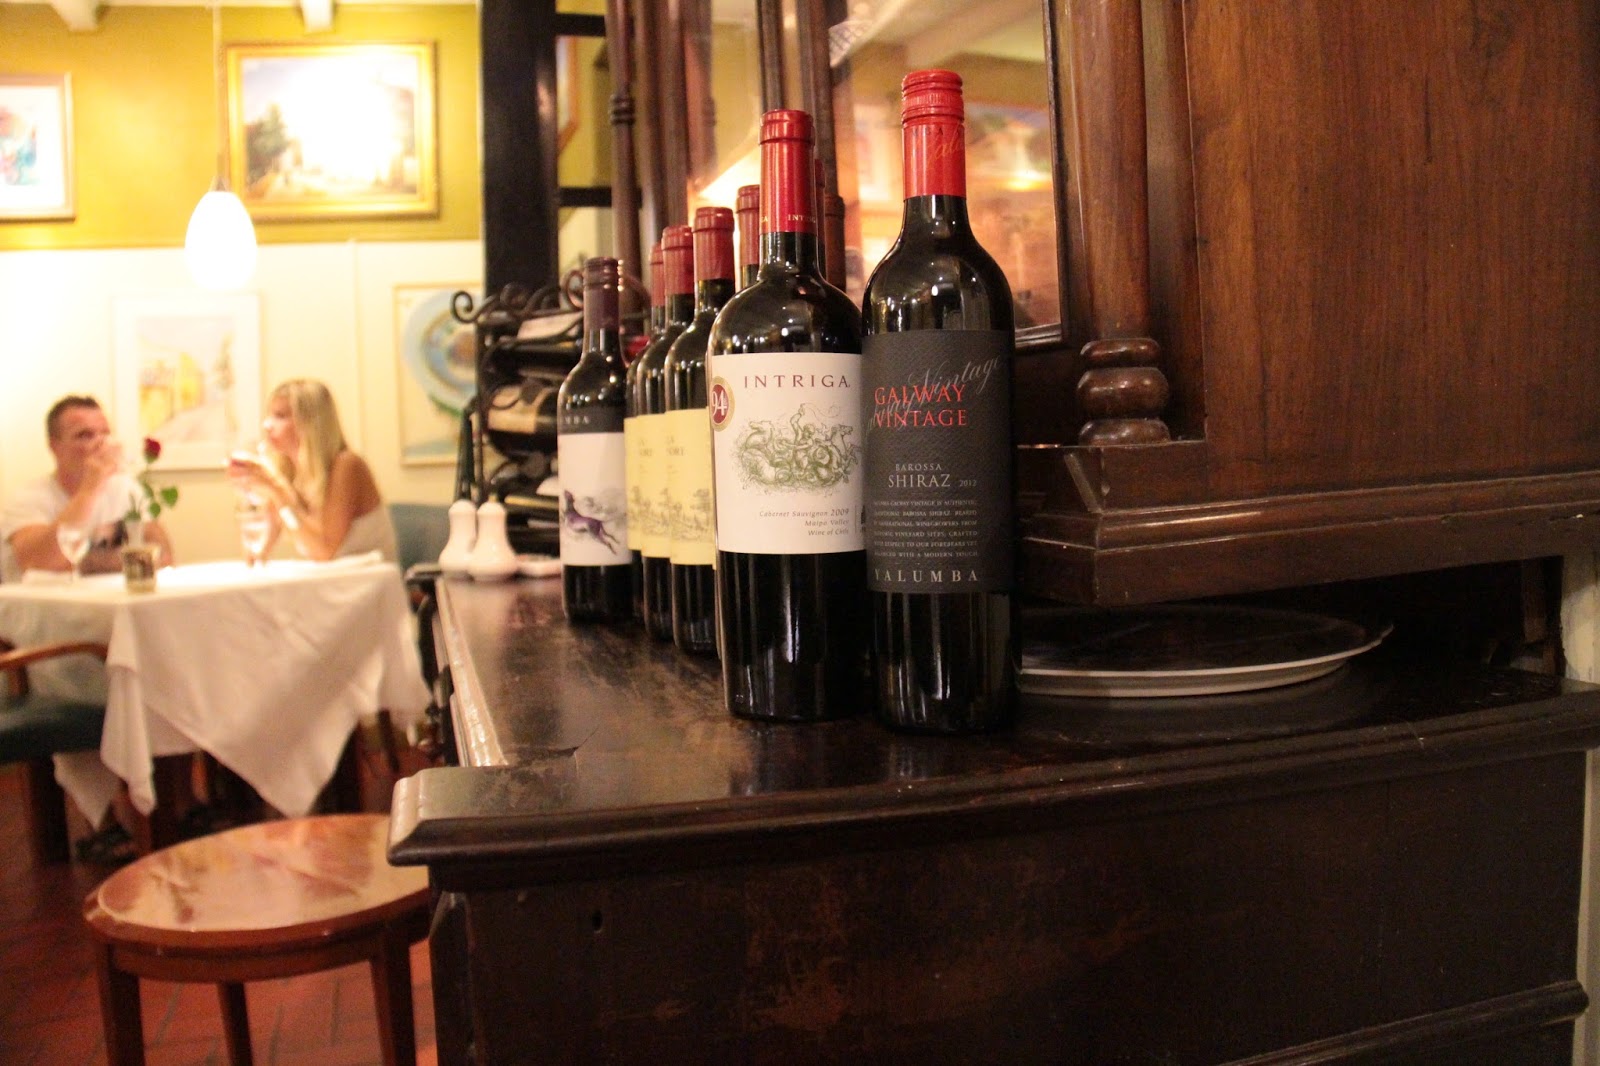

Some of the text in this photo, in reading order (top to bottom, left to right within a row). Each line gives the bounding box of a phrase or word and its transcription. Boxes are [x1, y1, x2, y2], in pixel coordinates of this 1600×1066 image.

[744, 374, 849, 388] INTRIGA
[874, 384, 966, 405] GALWAY
[874, 409, 967, 429] VINTAGE
[895, 463, 942, 471] BAROSSA
[888, 473, 951, 488] SHIRAZ
[792, 510, 828, 518] Sauvignon
